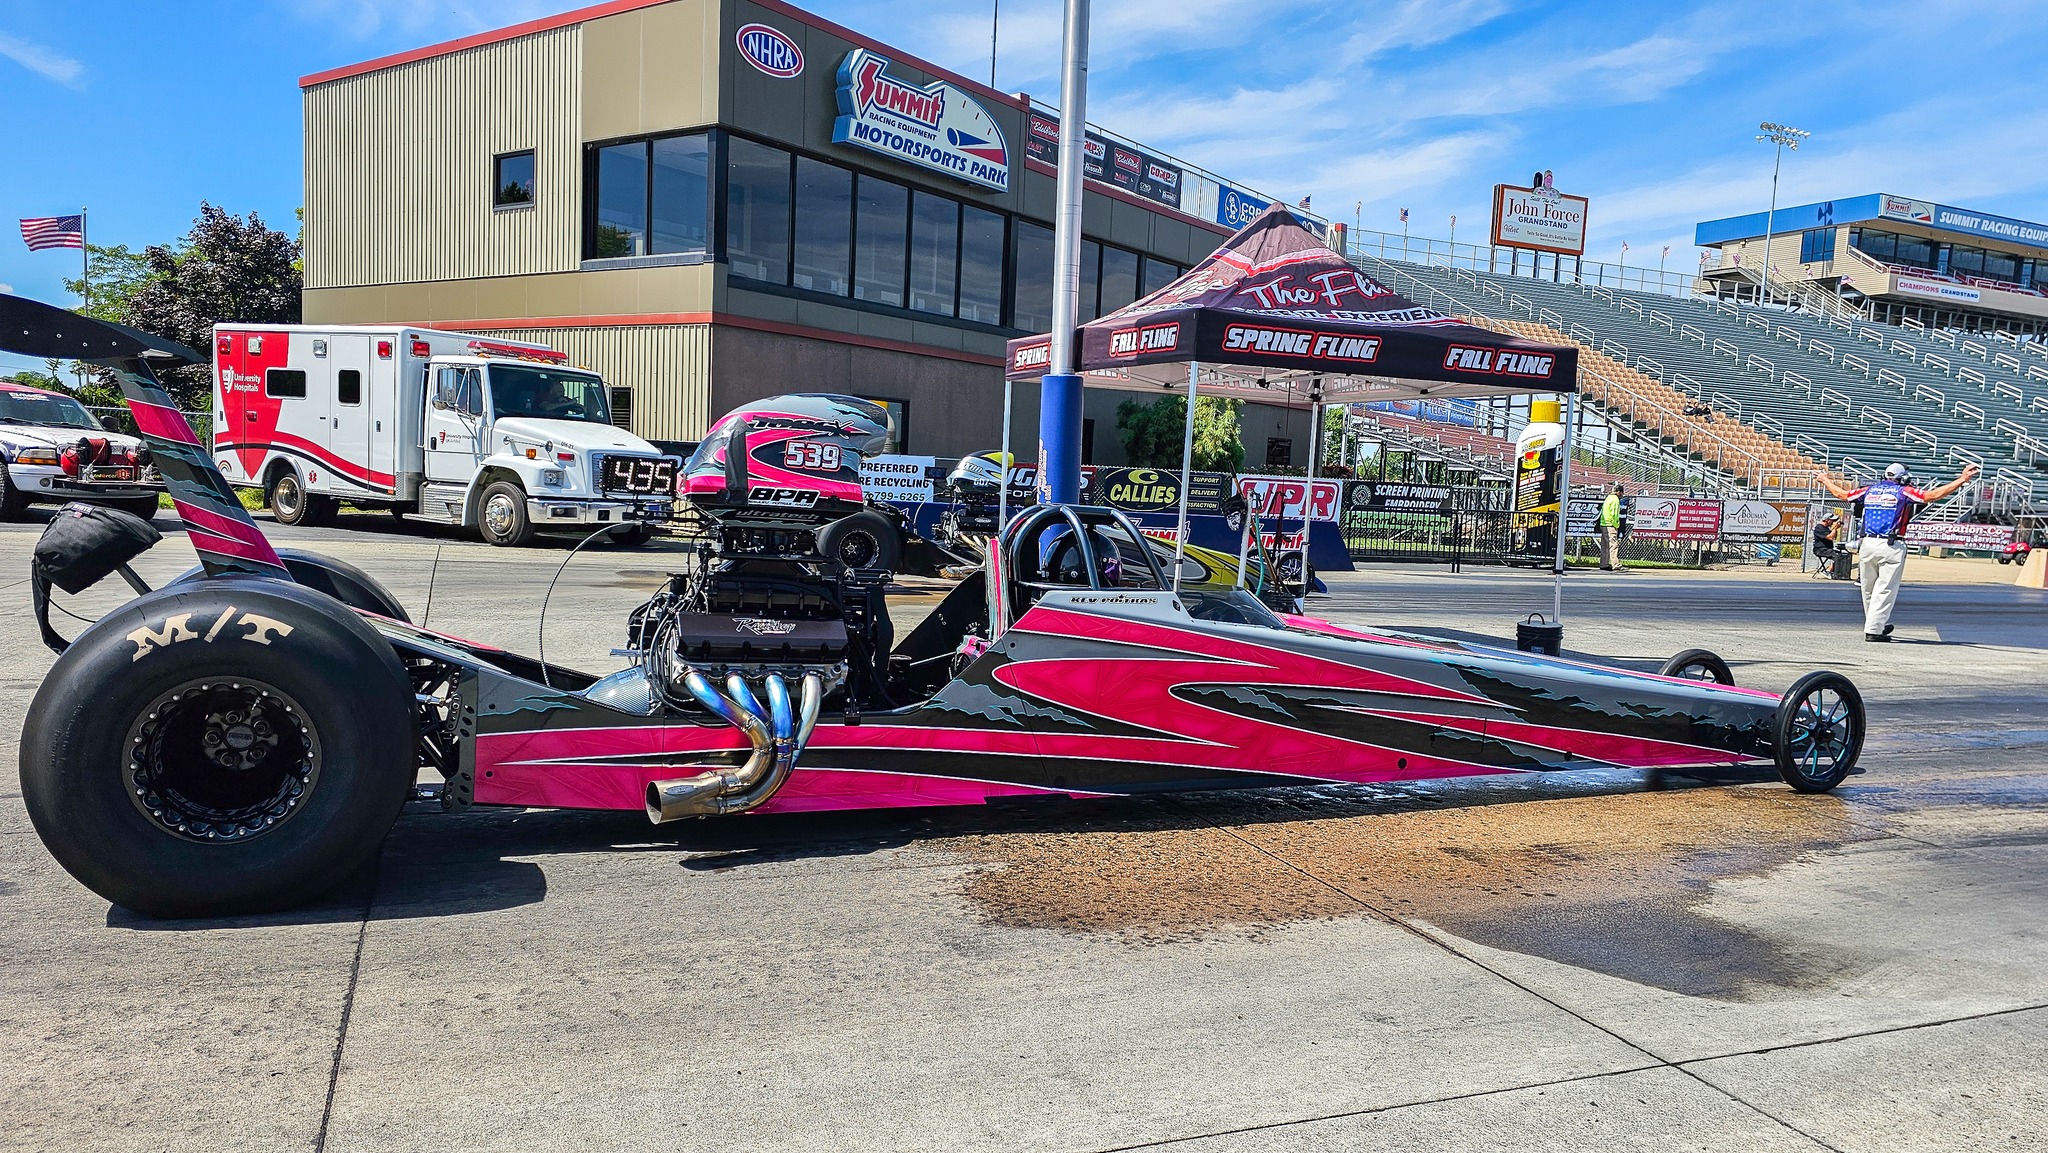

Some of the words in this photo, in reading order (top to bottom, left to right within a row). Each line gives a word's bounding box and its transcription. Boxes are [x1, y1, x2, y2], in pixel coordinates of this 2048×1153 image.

[748, 33, 794, 70] NHRA
[869, 112, 896, 128] RACING
[897, 122, 937, 142] EQUIPMENT
[853, 121, 967, 172] MOTORSPORTS
[969, 161, 1008, 186] PARK
[1150, 166, 1171, 182] COMP
[1507, 198, 1538, 217] John
[1543, 203, 1580, 223] Force
[1518, 216, 1568, 230] GRANDSTAND
[1940, 212, 1980, 229] SUMMIT
[1981, 220, 2018, 237] RACING
[2019, 227, 2048, 242] EQUIP
[1239, 276, 1316, 309] The
[1320, 269, 1392, 306] Fli
[1899, 281, 1939, 294] CHAMPIONS
[1940, 288, 1979, 299] GRANDSTAND
[1337, 308, 1445, 322] EXPERIEN
[1111, 333, 1137, 353] FALL
[1139, 327, 1177, 350] FLING
[1225, 328, 1311, 353] SPRING
[1312, 337, 1380, 360] FLING
[1015, 348, 1048, 368] SPRING
[1447, 348, 1495, 371] FALL
[1496, 352, 1553, 376] FLING
[234, 373, 261, 384] University
[233, 383, 259, 393] Hospitals
[786, 442, 840, 469] 539
[860, 462, 919, 474] PREFERRED
[874, 477, 930, 489] RECYCLING
[1193, 476, 1220, 484] SUPPORT
[1109, 484, 1176, 504] CALLIES
[1375, 484, 1408, 496] SCREEN
[1409, 486, 1451, 499] PRINTING
[1242, 482, 1336, 517] UPR
[1384, 499, 1443, 512] EMBROIDERY
[736, 508, 820, 520] ultratech
[1635, 509, 1670, 517] REDLINE
[1780, 505, 1806, 513] Apartment
[1792, 516, 1805, 524] living
[1906, 523, 1983, 534] ansportation
[1723, 534, 1768, 542] TheVillageLife.com
[1917, 531, 1939, 539] Direct
[1942, 533, 1971, 542] Delivery
[126, 605, 295, 663] M/T
